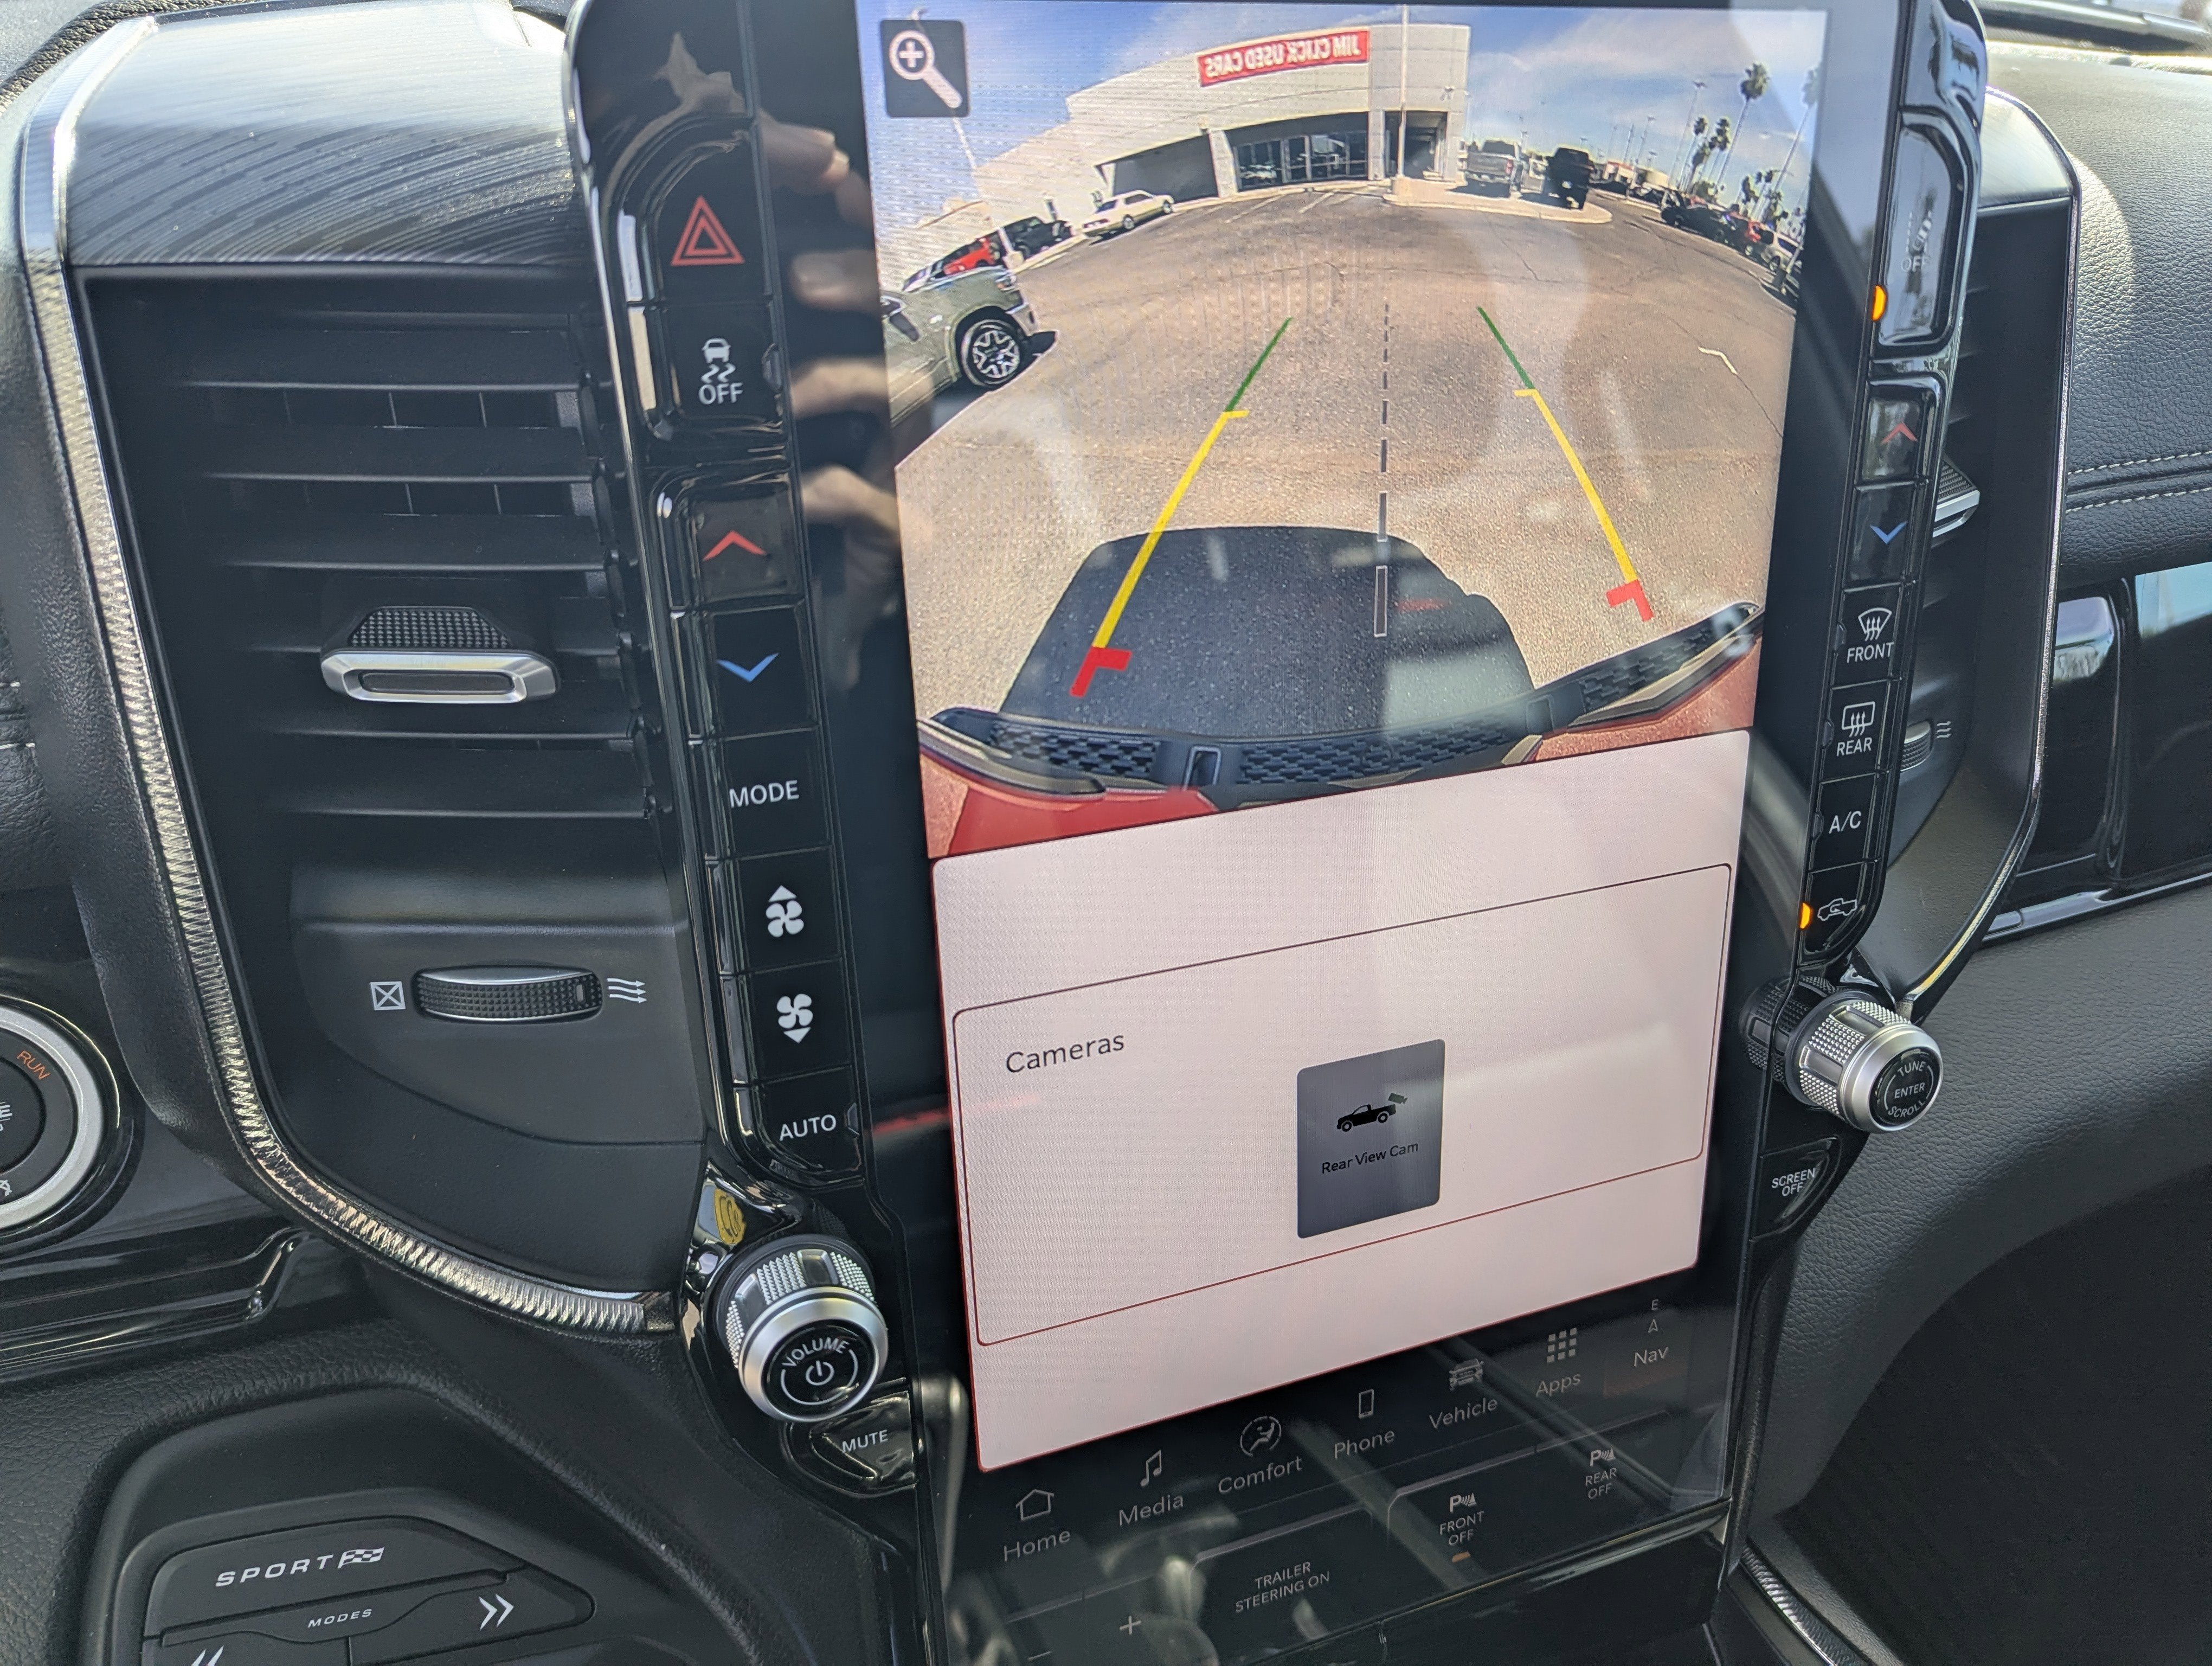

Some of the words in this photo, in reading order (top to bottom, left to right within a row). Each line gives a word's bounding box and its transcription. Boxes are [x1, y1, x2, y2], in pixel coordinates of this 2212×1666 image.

[1901, 255, 1929, 272] OFF
[698, 382, 743, 405] OFF
[1847, 642, 1894, 663] FRONT
[1836, 737, 1872, 757] REAR
[729, 780, 800, 808] MODE
[1829, 811, 1861, 834] A/C
[16, 1050, 51, 1080] RUN
[1006, 1034, 1124, 1073] Cameras
[1898, 1061, 1926, 1077] TUNE
[1894, 1082, 1925, 1099] ENTER
[1888, 1100, 1925, 1118] SCROLL
[779, 1114, 837, 1141] AUTO
[1321, 1157, 1353, 1174] Rear
[1355, 1150, 1387, 1165] View
[1390, 1143, 1419, 1157] Cam
[1771, 1168, 1816, 1188] SCREEN
[1782, 1182, 1804, 1196] OFF
[1651, 1299, 1659, 1310] E
[781, 1337, 850, 1367] VOLUME
[1634, 1347, 1669, 1367] Nav
[1535, 1373, 1581, 1398] Apps
[1429, 1396, 1499, 1430] Vehicle
[842, 1429, 889, 1452] MUTE
[1334, 1430, 1396, 1459] Phone
[1218, 1455, 1302, 1494] Comfort
[1585, 1468, 1617, 1486] REAR
[1588, 1483, 1612, 1499] OFF
[1118, 1494, 1184, 1526] Media
[1440, 1510, 1484, 1535] FRONT
[1004, 1529, 1071, 1561] Home
[1448, 1529, 1474, 1546] OFF
[215, 1554, 334, 1587] SPORT
[1255, 1561, 1310, 1589] TRAILER
[1236, 1580, 1304, 1612] STEERING
[1308, 1571, 1330, 1588] ON
[307, 1609, 372, 1628] MODES
